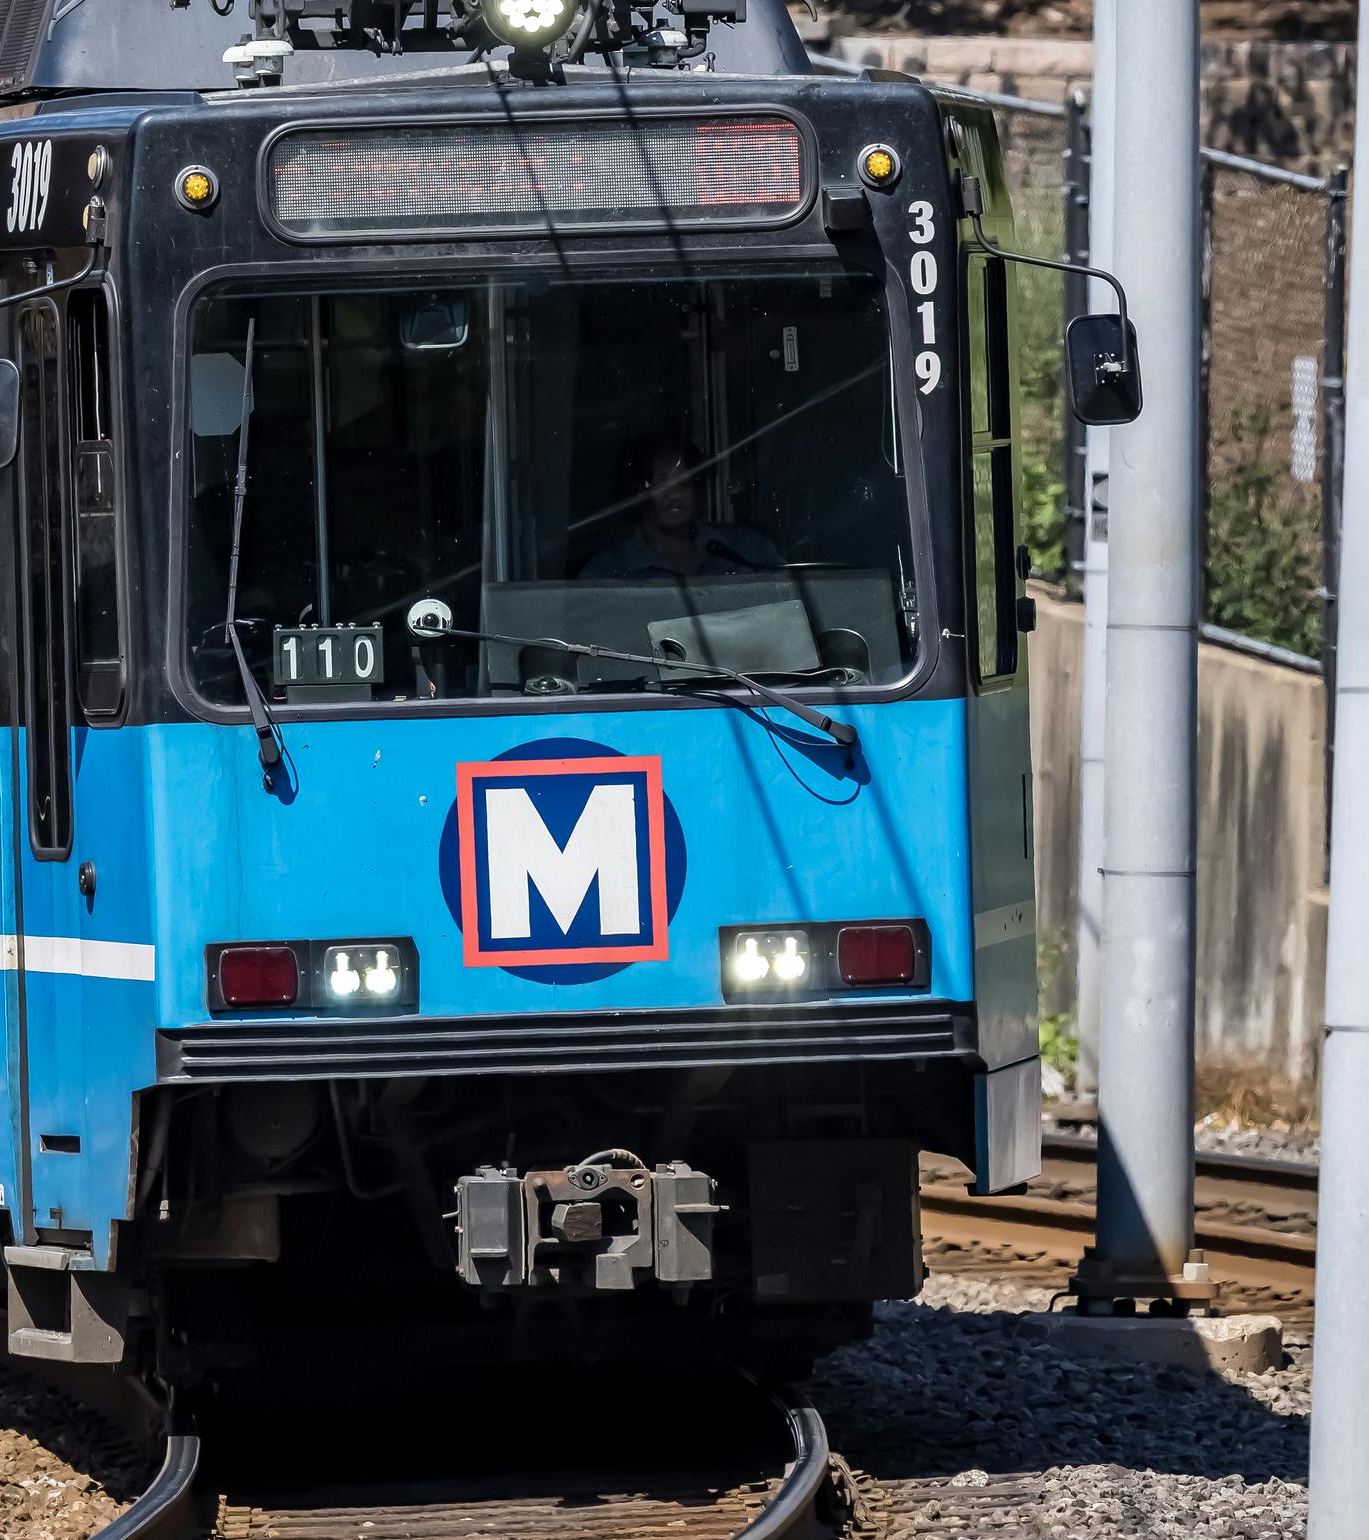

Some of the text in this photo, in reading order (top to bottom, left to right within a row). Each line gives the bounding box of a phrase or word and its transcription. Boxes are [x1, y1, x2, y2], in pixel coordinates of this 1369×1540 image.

[7, 139, 52, 232] 3019
[908, 200, 941, 396] 3019
[282, 635, 374, 680] 110
[484, 784, 641, 940] M
